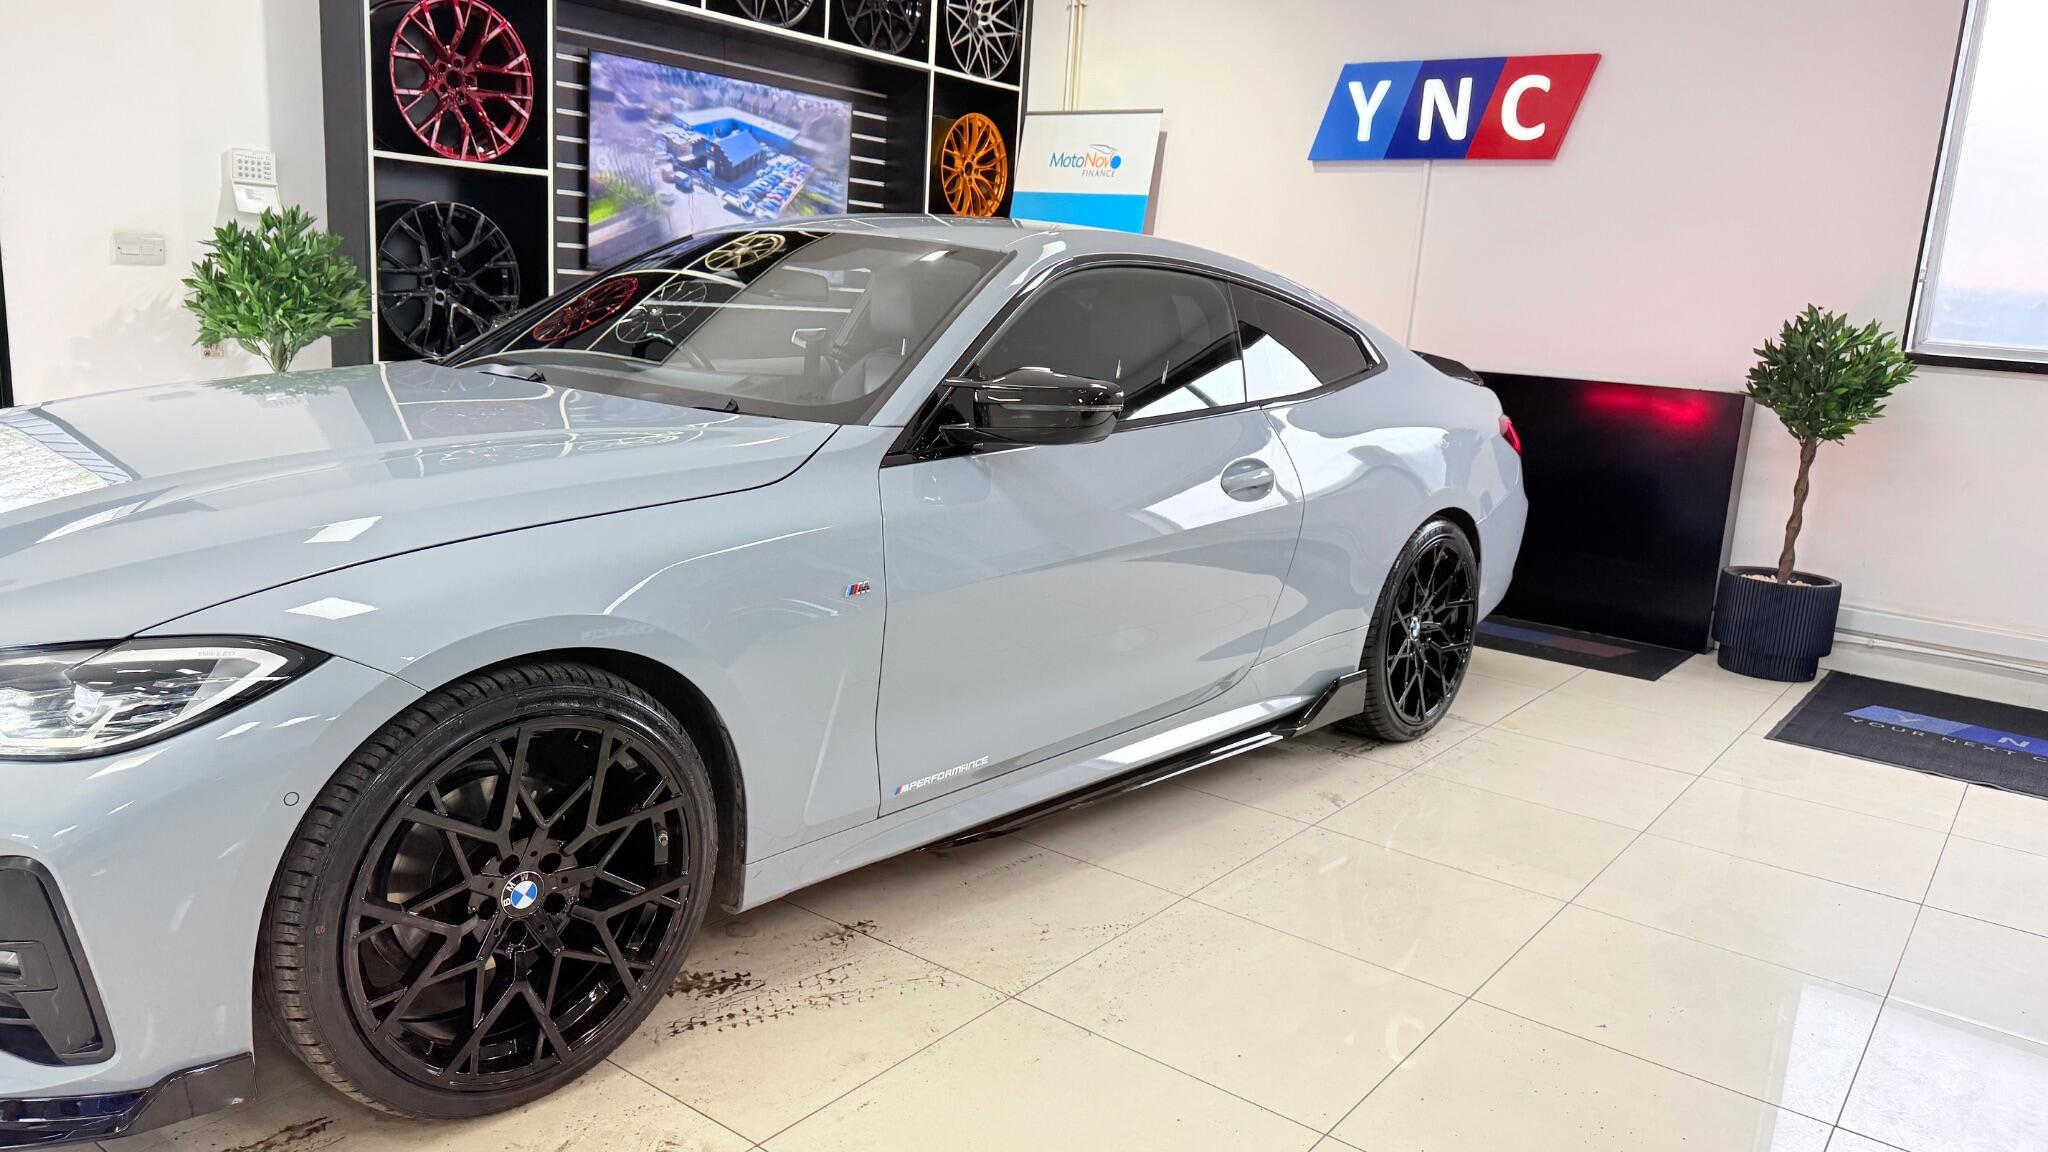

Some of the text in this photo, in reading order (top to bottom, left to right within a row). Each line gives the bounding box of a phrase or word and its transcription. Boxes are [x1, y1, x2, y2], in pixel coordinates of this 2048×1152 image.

[1348, 74, 1551, 142] YNC
[1049, 151, 1122, 169] MotoNovo
[1081, 169, 1116, 177] FINANCE
[1849, 717, 1926, 737] YOUR
[1942, 736, 2017, 756] NEXT
[503, 872, 530, 908] BMW
